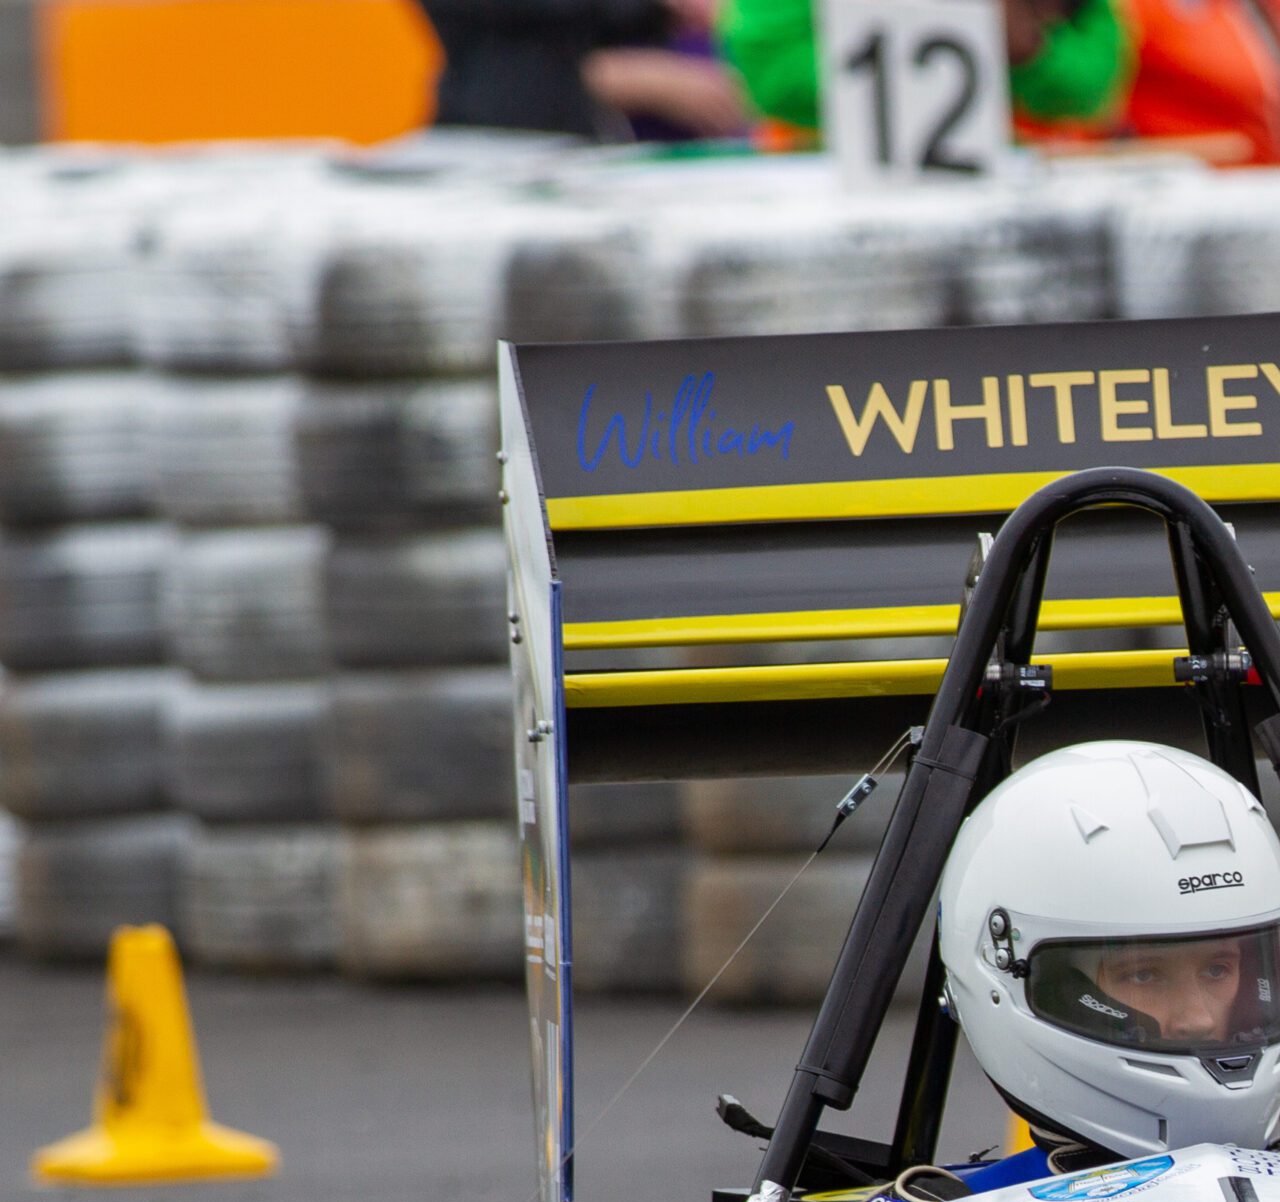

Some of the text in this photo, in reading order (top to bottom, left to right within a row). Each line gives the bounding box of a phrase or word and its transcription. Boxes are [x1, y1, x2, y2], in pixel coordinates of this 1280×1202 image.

[845, 33, 987, 174] 12
[577, 371, 794, 472] William
[1178, 870, 1243, 894] sparco
